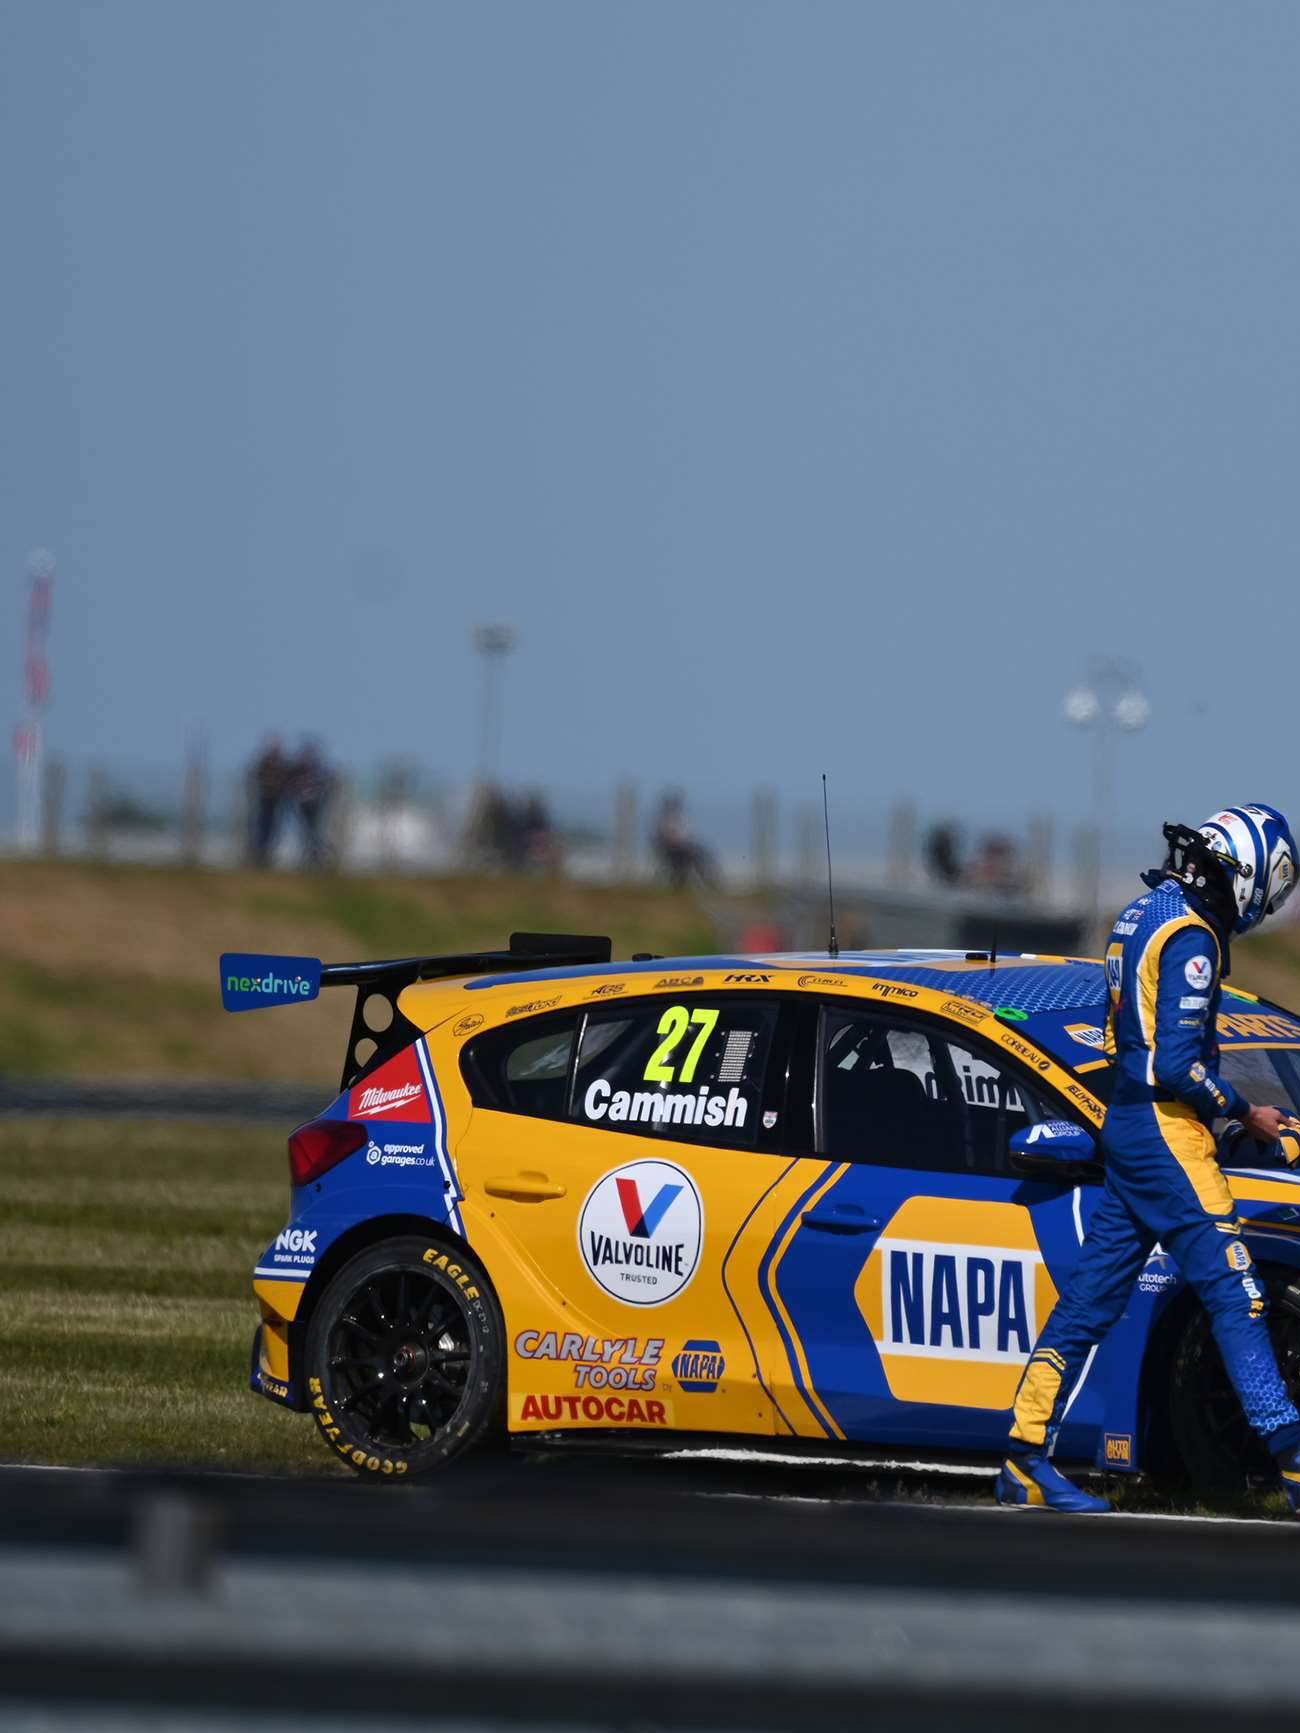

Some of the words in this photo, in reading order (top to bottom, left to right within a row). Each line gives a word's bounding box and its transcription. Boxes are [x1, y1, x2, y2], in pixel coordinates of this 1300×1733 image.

[227, 972, 310, 995] nexdrive
[643, 1005, 719, 1083] 27
[358, 1083, 421, 1110] Milwaukee
[584, 1079, 748, 1127] Cammish
[383, 1144, 424, 1155] approved
[275, 1229, 317, 1253] NGK
[590, 1231, 685, 1277] VALVOLINE
[273, 1254, 293, 1263] SPARK
[293, 1254, 316, 1265] PLUGS
[422, 1248, 480, 1301] EAGLE
[620, 1272, 658, 1286] TRUSTED
[1138, 1273, 1177, 1285] utotech
[890, 1249, 1032, 1354] NAPA
[515, 1330, 665, 1366] CARLYLE
[575, 1364, 656, 1391] TOOLS
[680, 1353, 717, 1379] NAPA
[521, 1395, 667, 1425] AUTOCAR
[308, 1376, 408, 1475] GOODYEAR
